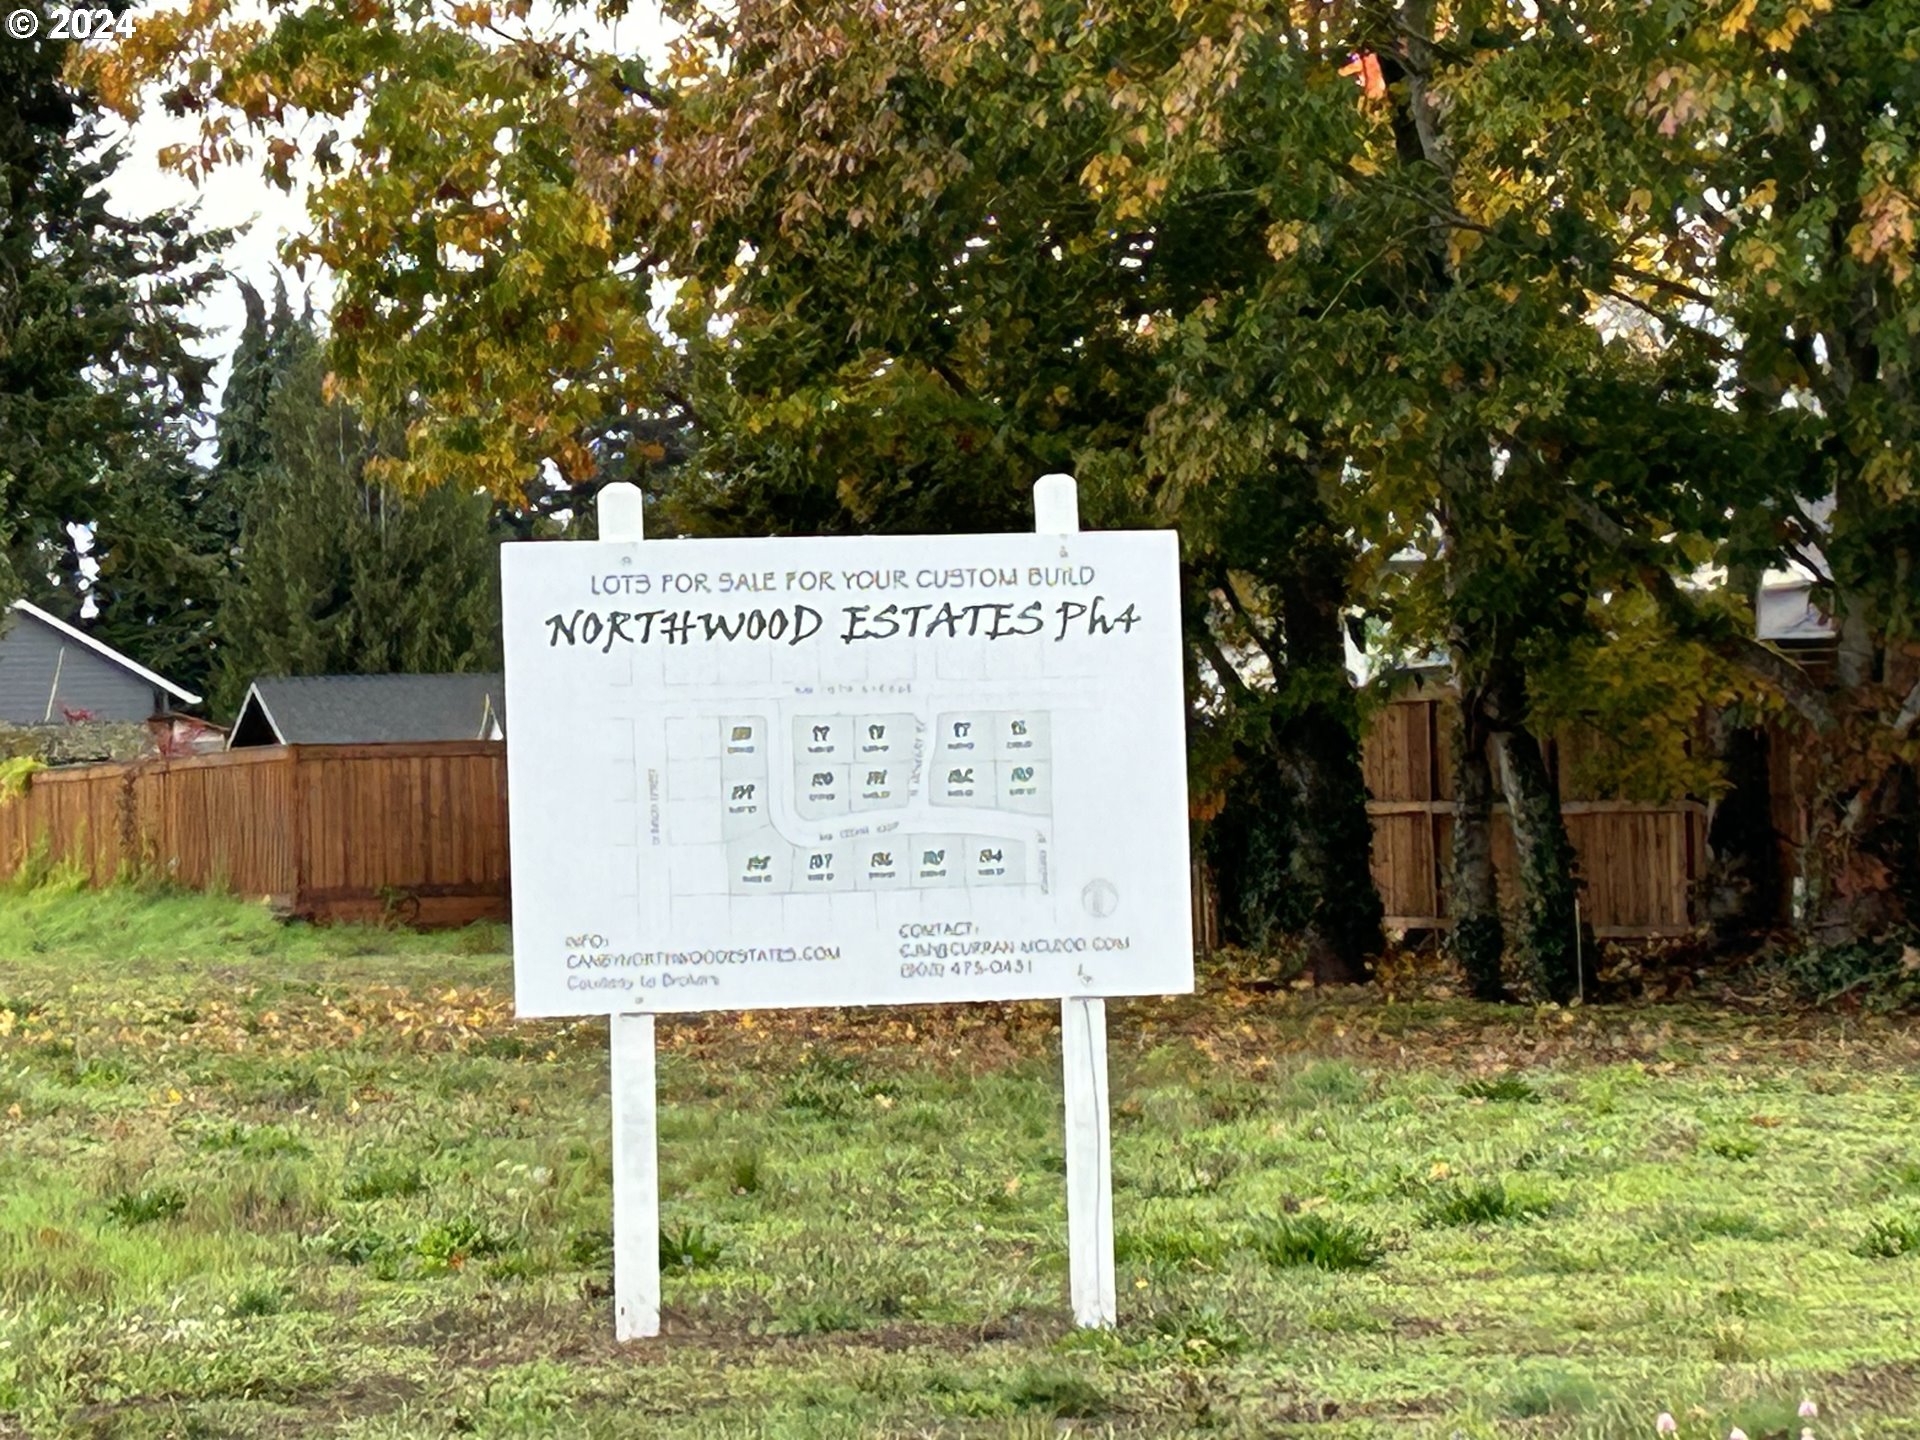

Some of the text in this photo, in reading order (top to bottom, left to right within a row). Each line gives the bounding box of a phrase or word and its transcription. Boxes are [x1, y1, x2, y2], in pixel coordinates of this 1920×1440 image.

[661, 573, 712, 593] FOR
[718, 572, 776, 593] SALE
[785, 571, 836, 591] FOR
[841, 570, 909, 590] YOUR
[916, 568, 1018, 589] CUSTOM
[1027, 566, 1096, 587] BUILD
[545, 596, 1142, 654] NORTHWOOD ESTATES Ph4
